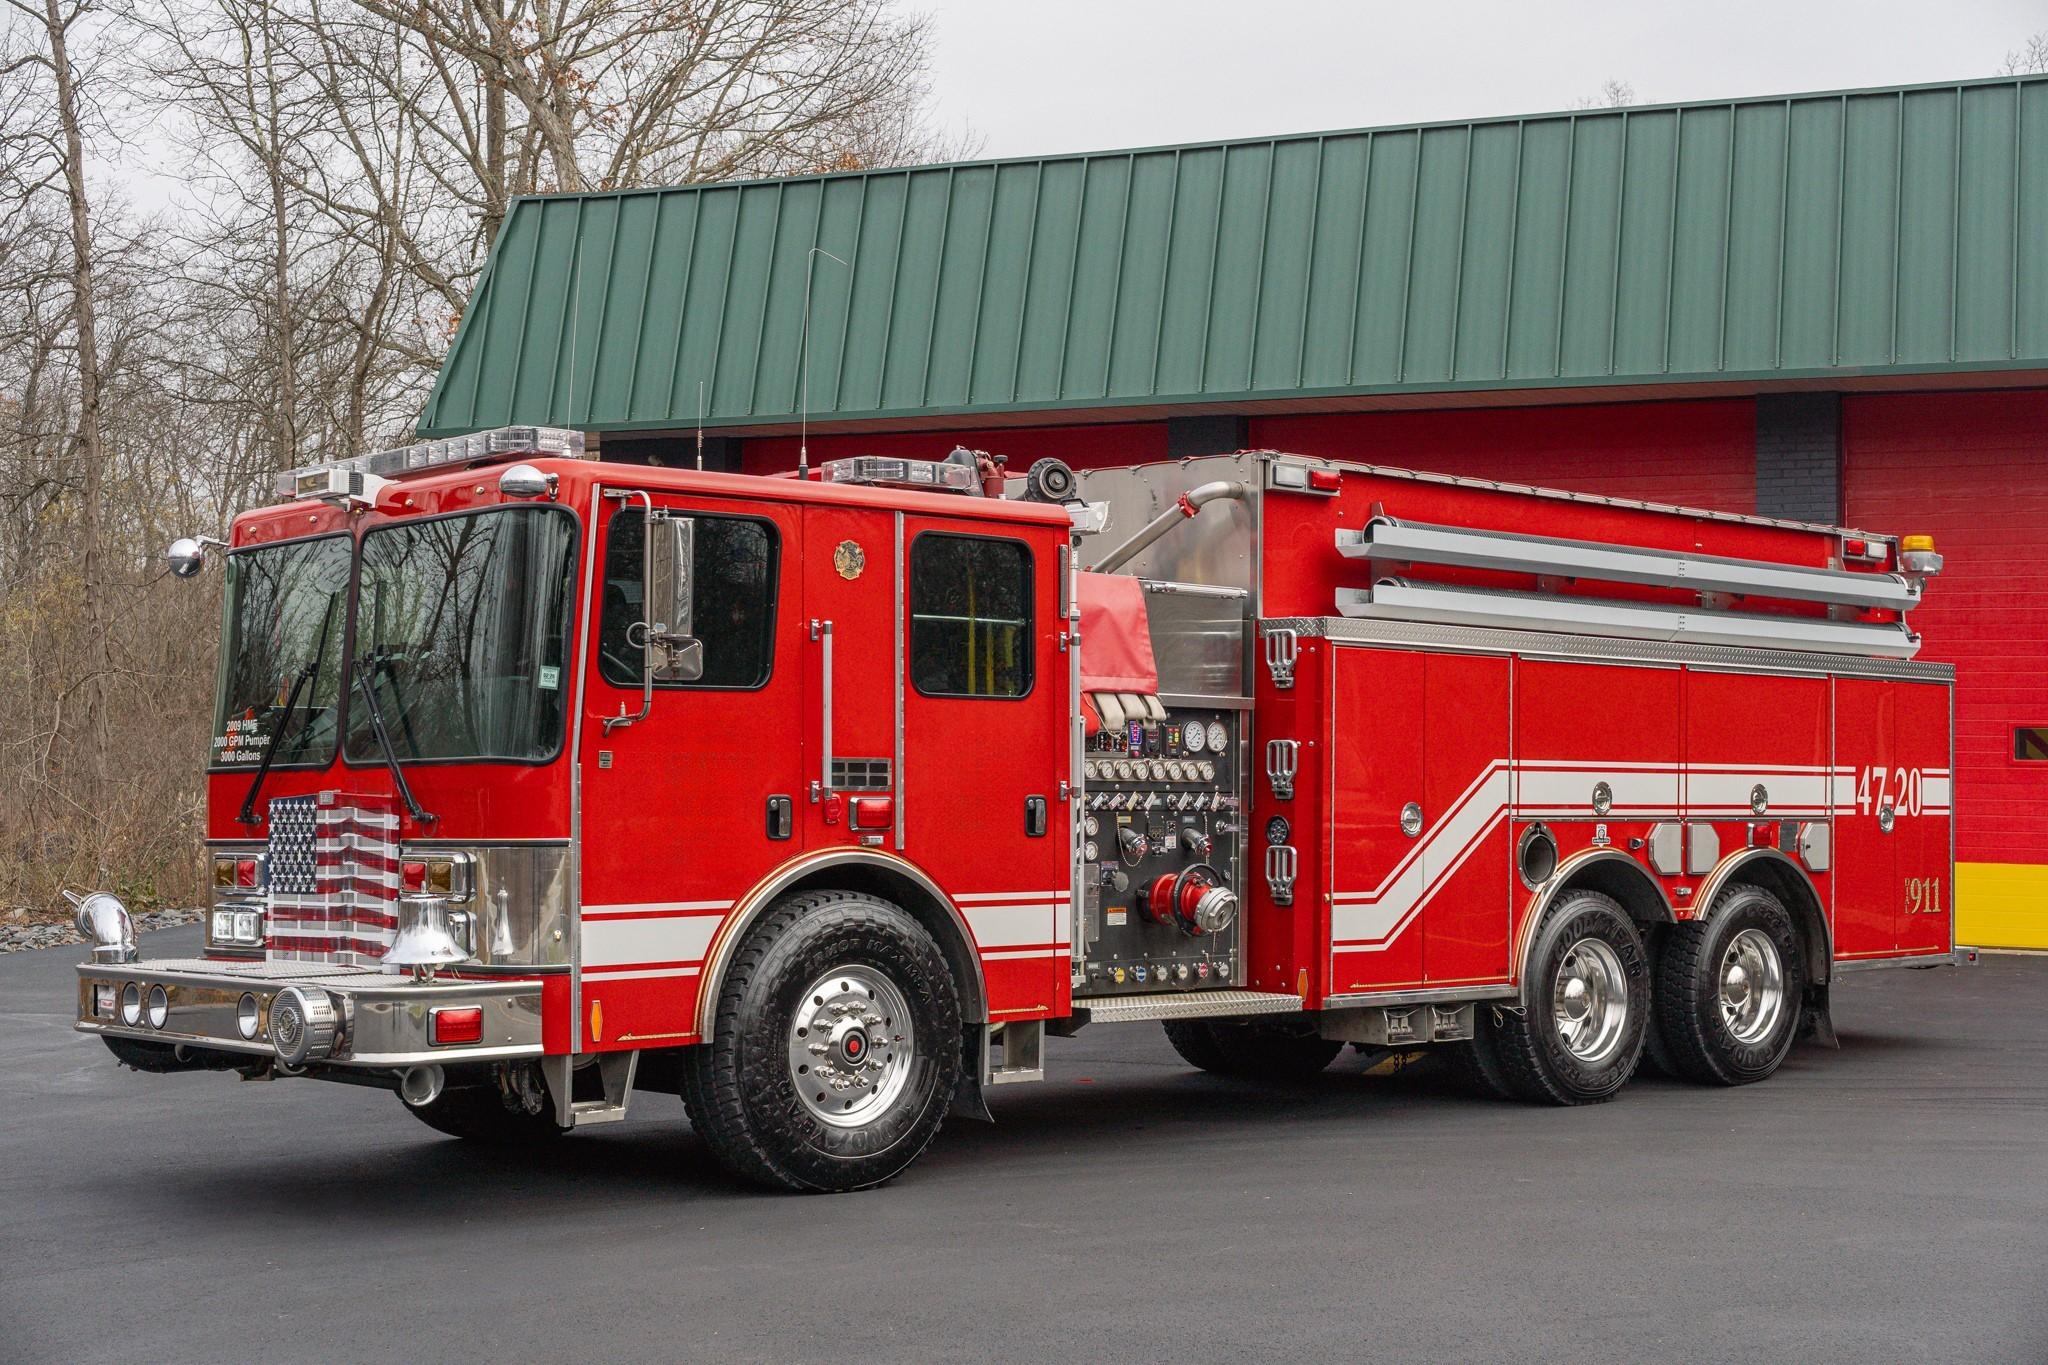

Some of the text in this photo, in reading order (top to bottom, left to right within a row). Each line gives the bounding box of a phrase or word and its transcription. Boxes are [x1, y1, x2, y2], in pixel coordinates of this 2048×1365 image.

[226, 719, 258, 732] 2009 HME
[213, 735, 271, 747] 2000 GPM Pumper
[220, 750, 261, 762] 3000 Gallons
[1857, 765, 1922, 817] 47-20
[1910, 877, 1942, 914] 911
